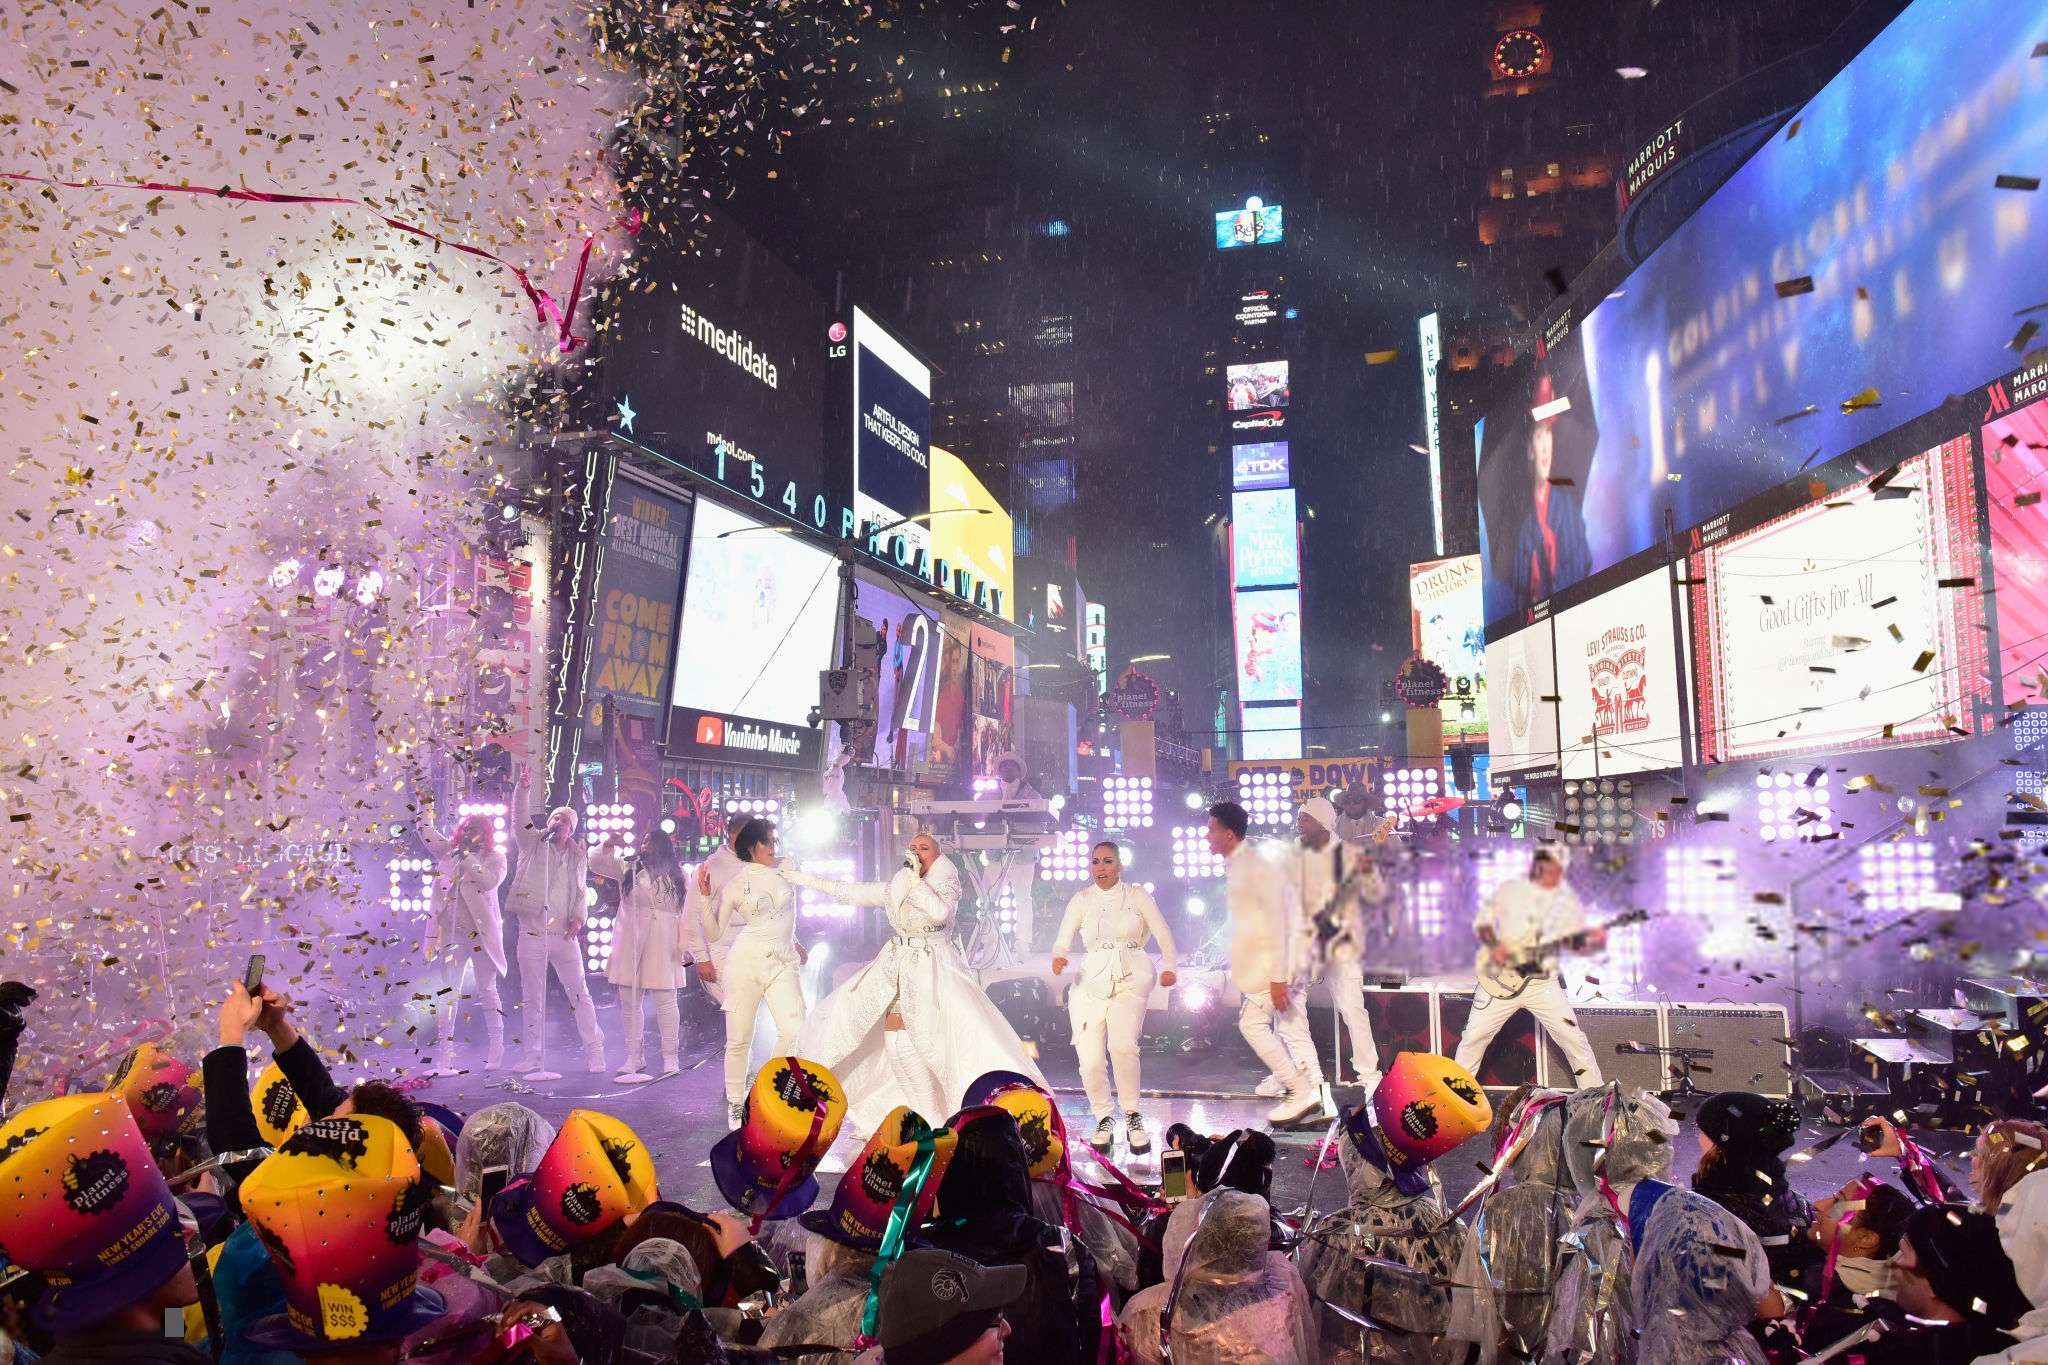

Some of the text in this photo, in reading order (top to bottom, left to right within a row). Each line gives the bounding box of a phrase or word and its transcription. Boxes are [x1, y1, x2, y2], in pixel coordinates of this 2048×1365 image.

[1628, 120, 1682, 178] MARRIOTT
[1629, 146, 1675, 196] MARQUIS
[1234, 310, 1277, 320] COUNTDOWN
[1546, 308, 1571, 339] MARRIOTT
[697, 315, 778, 389] medidata
[829, 345, 847, 358] LG
[873, 403, 920, 447] ARTFUL DESIGN
[863, 413, 881, 437] THAT
[881, 426, 902, 451] KEEPS
[911, 446, 928, 469] COOL
[1247, 460, 1285, 472] TDK
[613, 514, 679, 560] BEST MUSICAL
[1702, 513, 1731, 533] MARRIOTT
[1702, 526, 1728, 543] MARQUIS
[1416, 559, 1475, 595] DRUNK
[606, 589, 673, 637] COME
[1759, 599, 1792, 632] Good
[1794, 591, 1826, 627] Gifts
[1826, 583, 1850, 621] for
[1586, 640, 1601, 657] LEVI
[1601, 626, 1629, 651] STRAUSS
[1629, 627, 1636, 643] &
[1635, 623, 1648, 641] CO.
[595, 656, 666, 699] AWAY
[907, 613, 946, 734] 21
[1401, 680, 1434, 689] planet
[1117, 693, 1148, 703] planet
[1406, 688, 1442, 696] fitness
[724, 720, 801, 755] YouTube Music
[1405, 1107, 1427, 1133] planet
[296, 1126, 361, 1145] planet
[74, 1168, 116, 1208] planet
[85, 1169, 128, 1208] fitness
[864, 1165, 893, 1189] planet
[864, 1175, 897, 1198] fitness
[566, 1189, 590, 1216] planet
[97, 1202, 166, 1262] NEW YEAR'S EVE
[390, 1208, 420, 1232] plane
[130, 1226, 158, 1251] SQUARE
[327, 1302, 354, 1314] WIN
[330, 1313, 358, 1329] $$$
